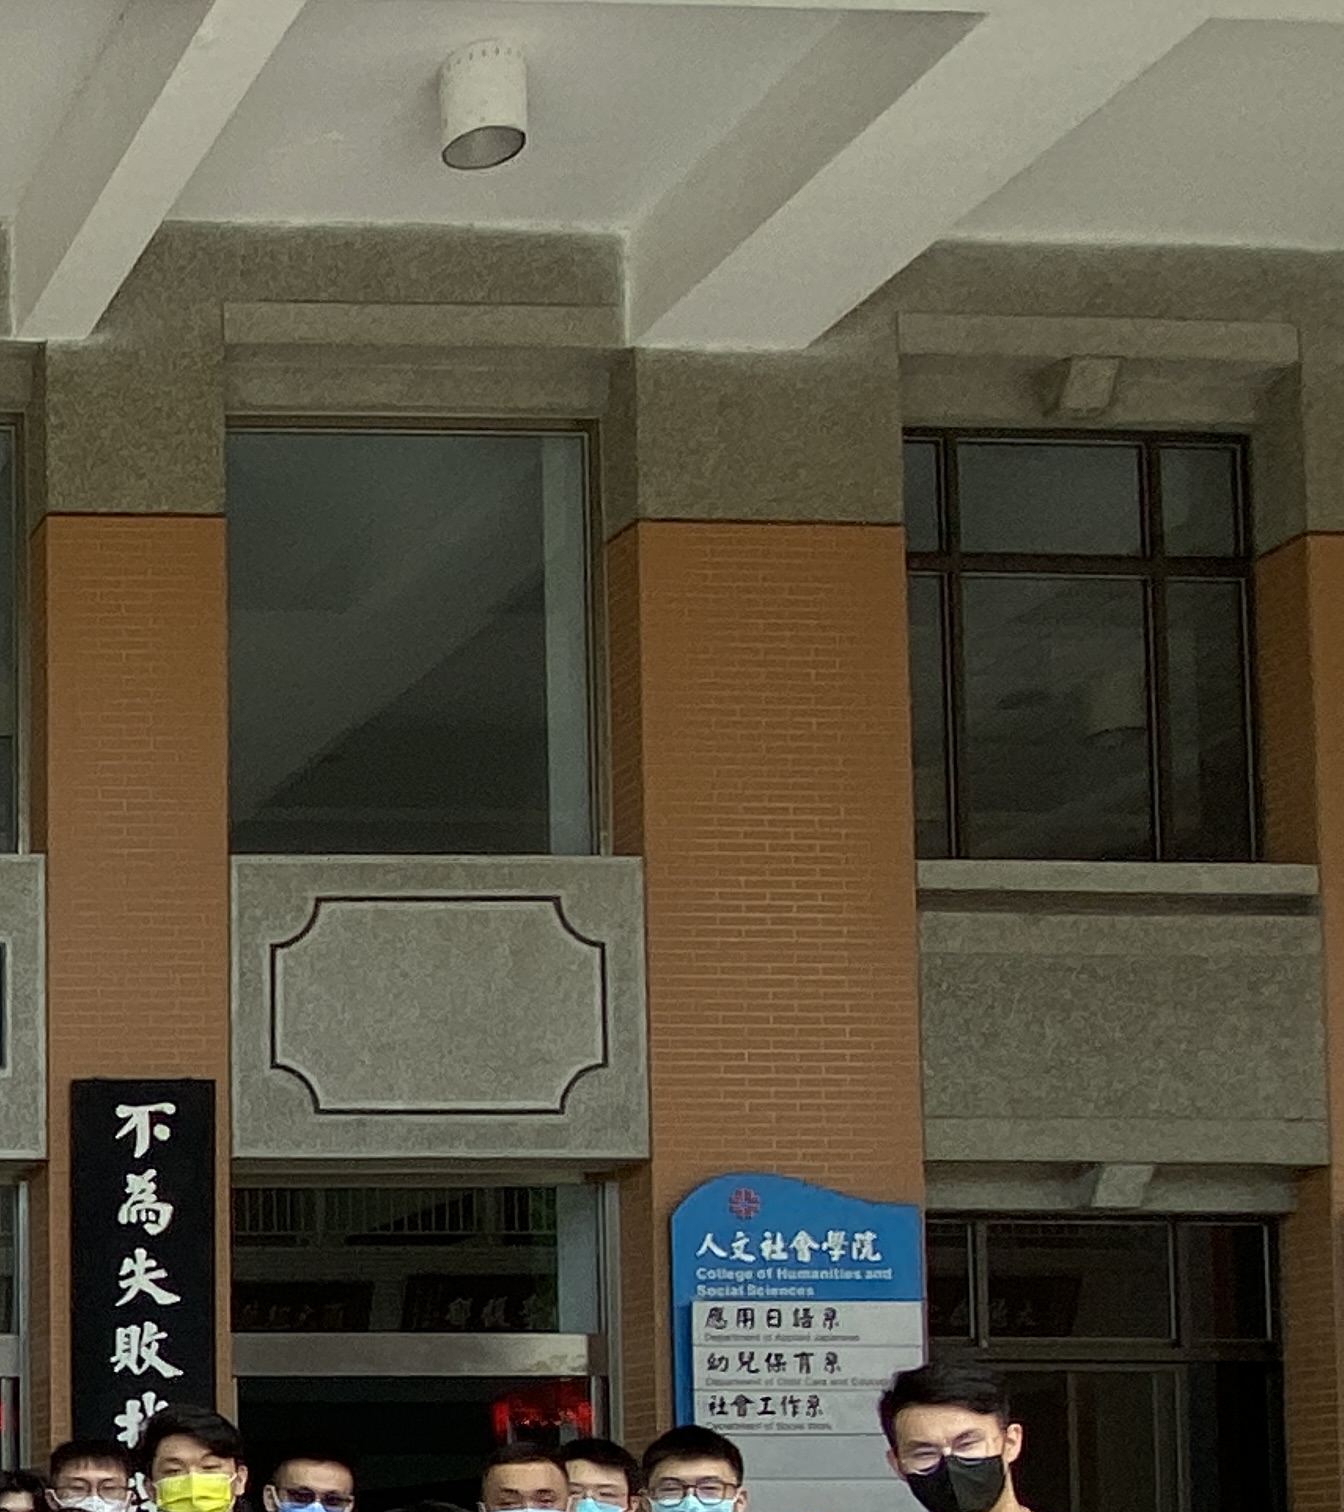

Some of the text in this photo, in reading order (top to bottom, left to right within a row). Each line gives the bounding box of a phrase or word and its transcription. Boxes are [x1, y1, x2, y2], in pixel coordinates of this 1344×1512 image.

[696, 1230, 882, 1262] 人文社會學院
[695, 1267, 893, 1282] College of Humanities and
[697, 1283, 814, 1296] Social Sciences
[705, 1306, 840, 1331] 應用日語系
[707, 1351, 841, 1374] 幼兒保育系
[708, 1393, 824, 1418] 社會工作系
